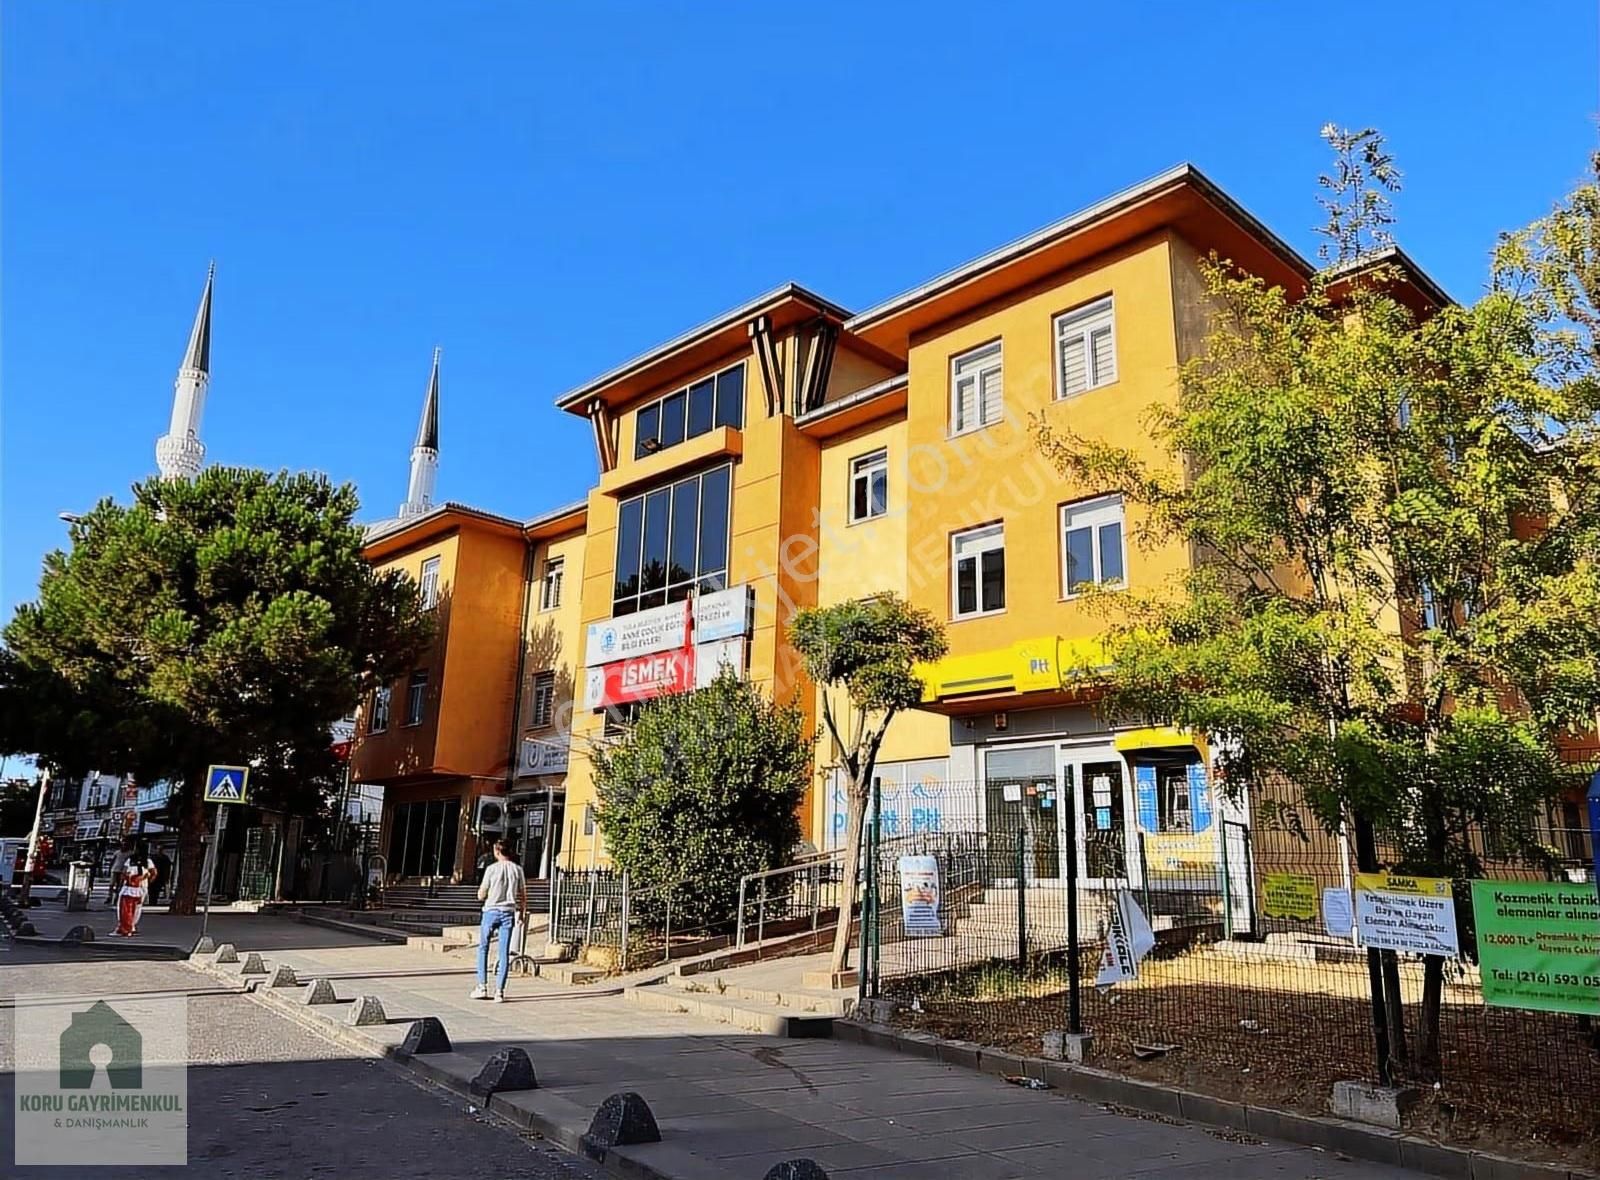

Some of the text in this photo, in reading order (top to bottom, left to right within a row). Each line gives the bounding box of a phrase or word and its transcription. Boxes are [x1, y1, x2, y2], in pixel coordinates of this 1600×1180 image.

[1494, 891, 1554, 905] Kozmetik
[1497, 905, 1600, 920] elemanlar alına
[1364, 916, 1397, 927] Eleman
[1491, 969, 1600, 987] Tel: (216) 593 05
